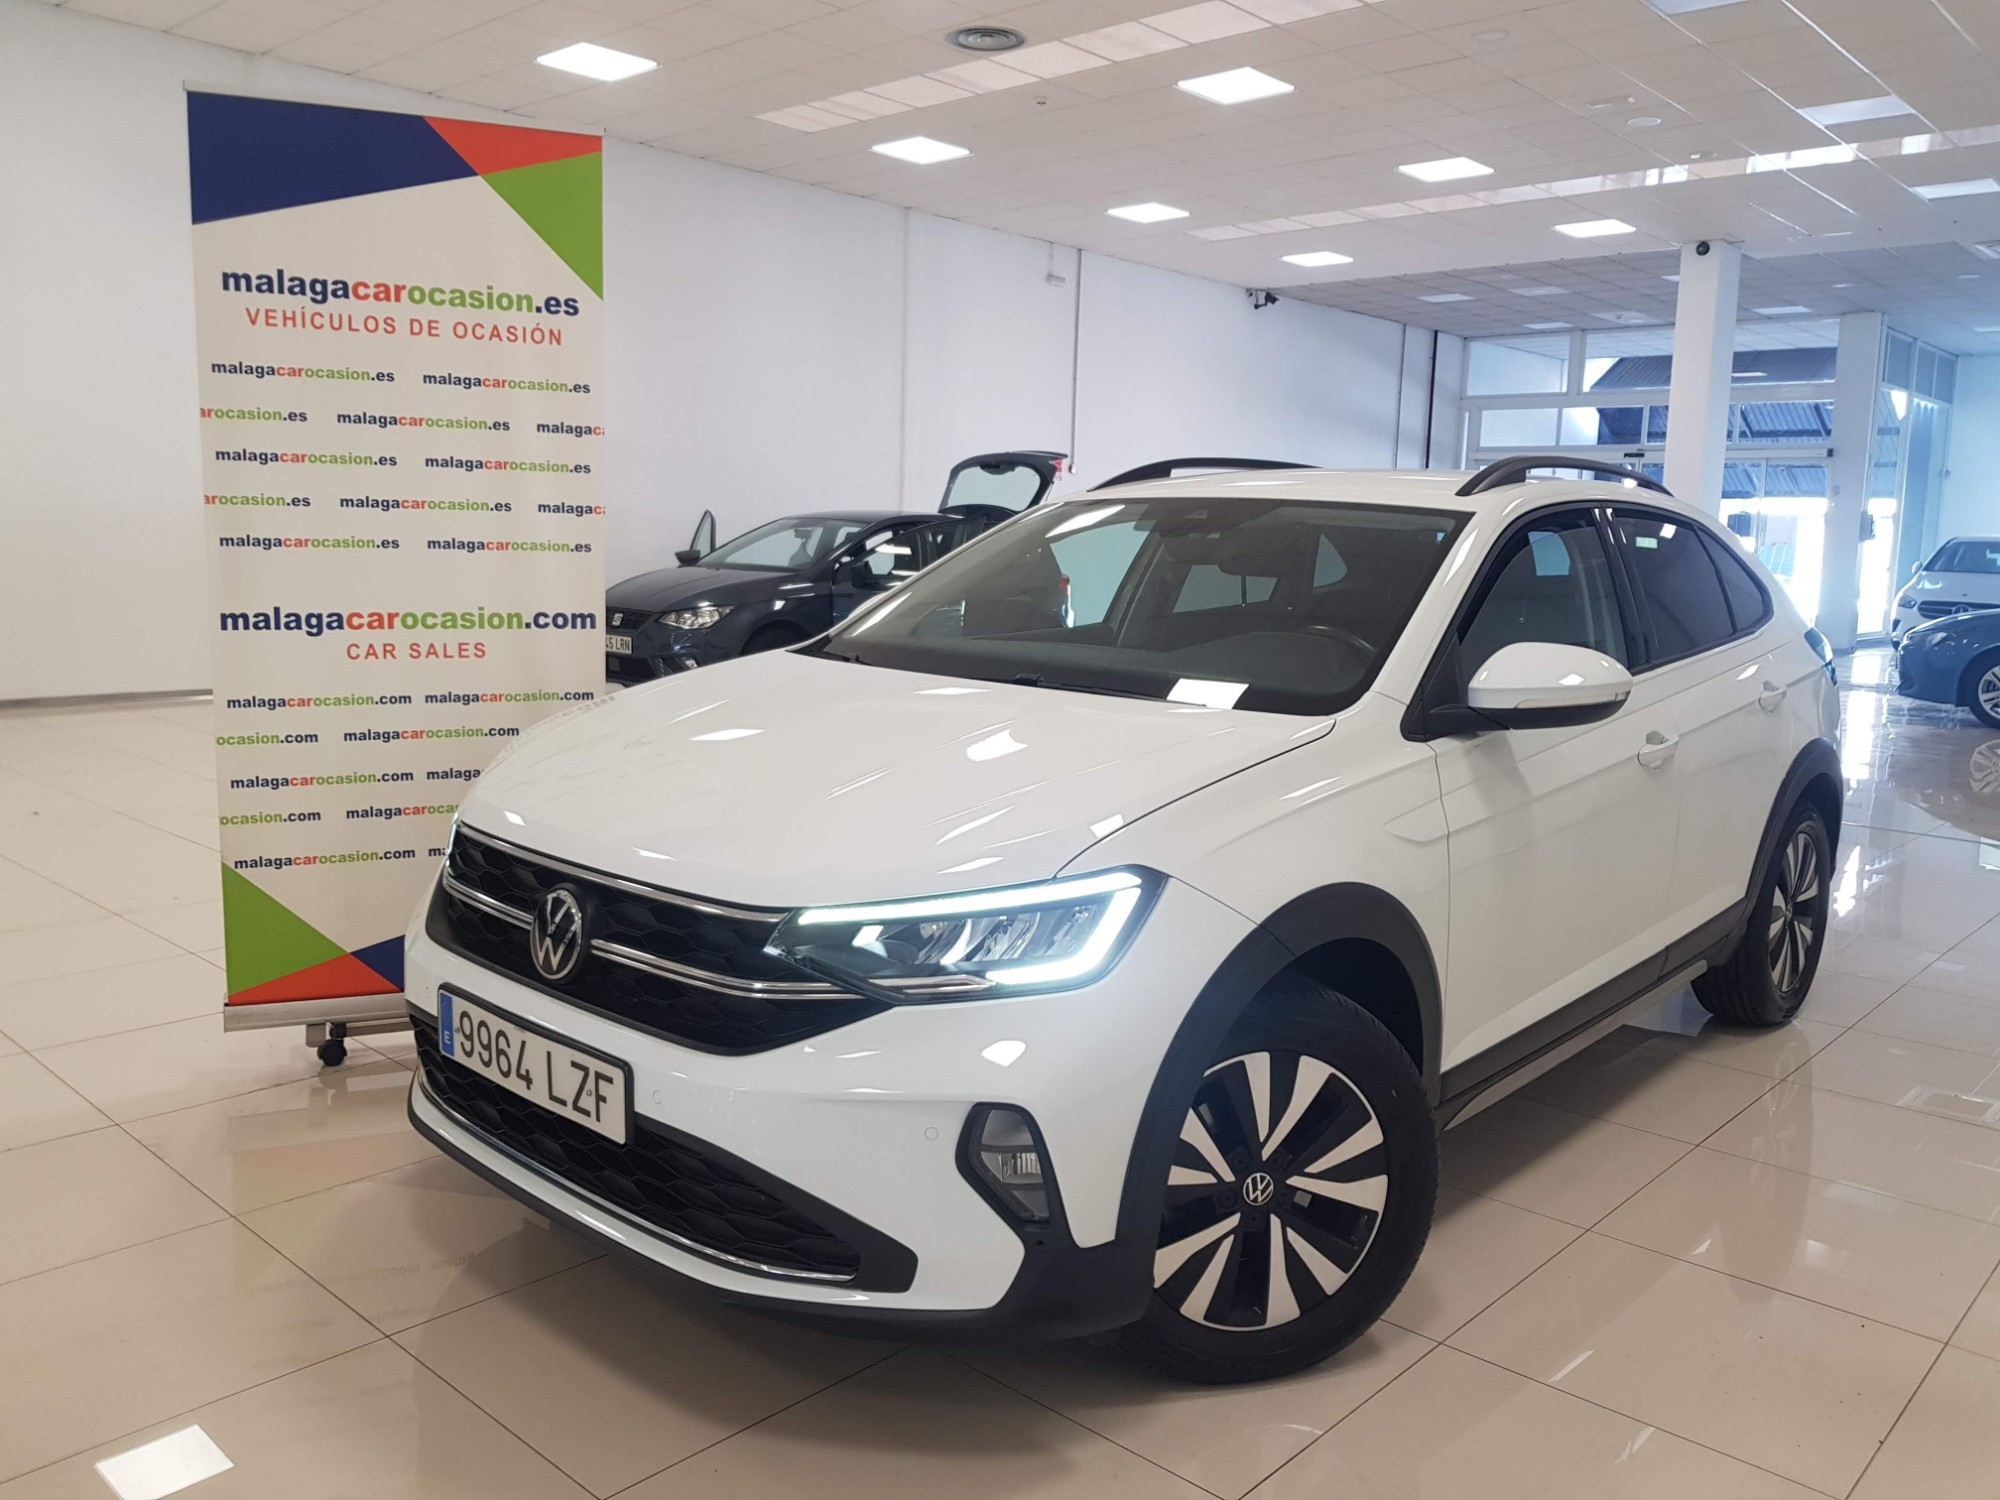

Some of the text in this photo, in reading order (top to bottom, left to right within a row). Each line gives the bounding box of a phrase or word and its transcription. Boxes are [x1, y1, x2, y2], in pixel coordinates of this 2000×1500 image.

[222, 268, 580, 316] malagacarocasion.es
[246, 306, 561, 345] VEHÍCULOS DE OCASIÓN
[211, 361, 395, 382] malagacarocasion.es
[423, 373, 590, 393] malagacarocasion.es
[337, 412, 510, 431] malagacarocasion.es
[537, 422, 604, 438] malagac
[216, 448, 397, 466] malagacarocasion.es
[425, 456, 591, 474] malagacarocasion.es
[340, 496, 512, 512] malagacarocasion.es
[538, 502, 605, 517] malagac
[220, 534, 399, 550] malagacarocasion.es
[427, 538, 592, 553] malagacarocasion.es
[220, 606, 596, 637] malagacarocasion.com
[347, 642, 485, 660] CAR SALES
[616, 637, 630, 653] LRN
[227, 694, 412, 711] malagacarocasion.com
[425, 690, 594, 706] malagacarocasion.com
[216, 732, 318, 745] ocasion.com
[344, 726, 519, 743] malagacarocasion.com
[231, 772, 414, 790] malagacarocasion.com
[220, 812, 321, 825] ocasion.com
[234, 849, 415, 869] malagacarocasion.com
[444, 1030, 451, 1045] E
[459, 1010, 614, 1123] 9964 LZF
